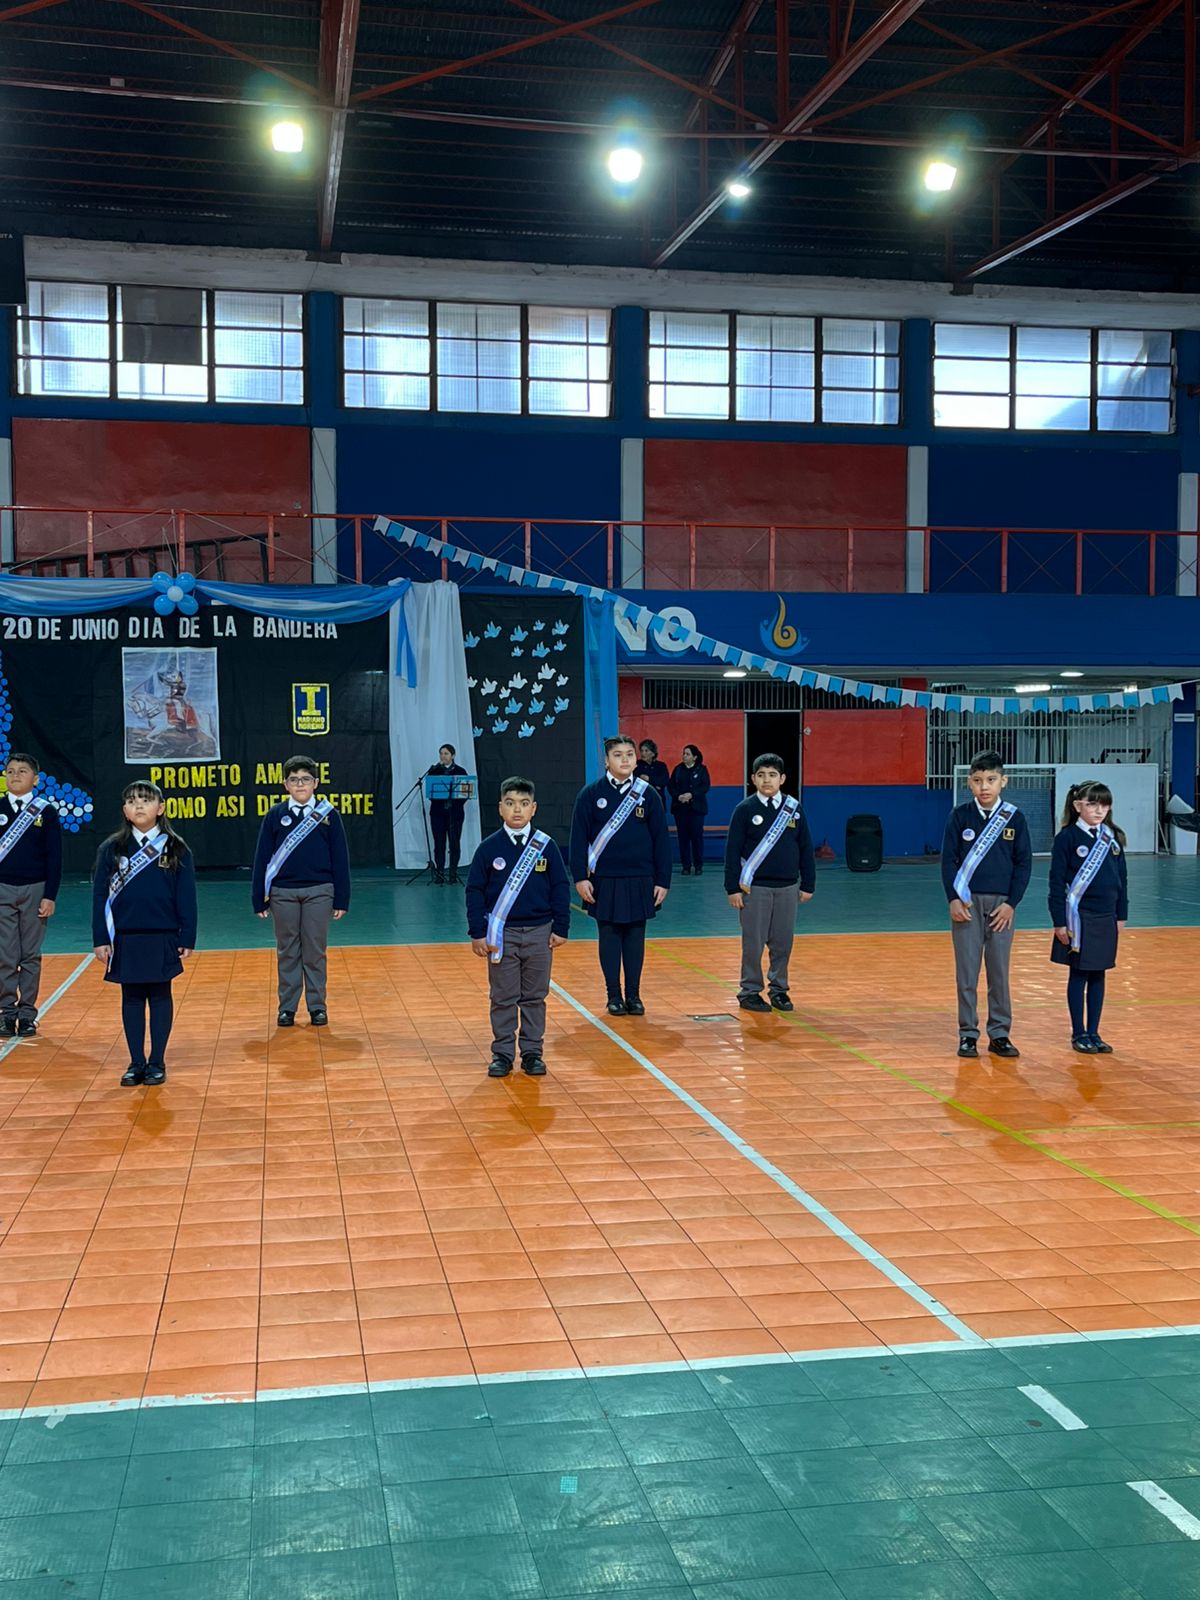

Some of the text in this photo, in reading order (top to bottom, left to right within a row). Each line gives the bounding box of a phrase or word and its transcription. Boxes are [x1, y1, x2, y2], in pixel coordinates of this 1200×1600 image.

[2, 615, 338, 641] 20 DE JUNIO DIA DE LA BANDERA
[150, 763, 241, 788] PROMETO
[164, 796, 206, 819] OMO
[216, 795, 244, 818] ASI
